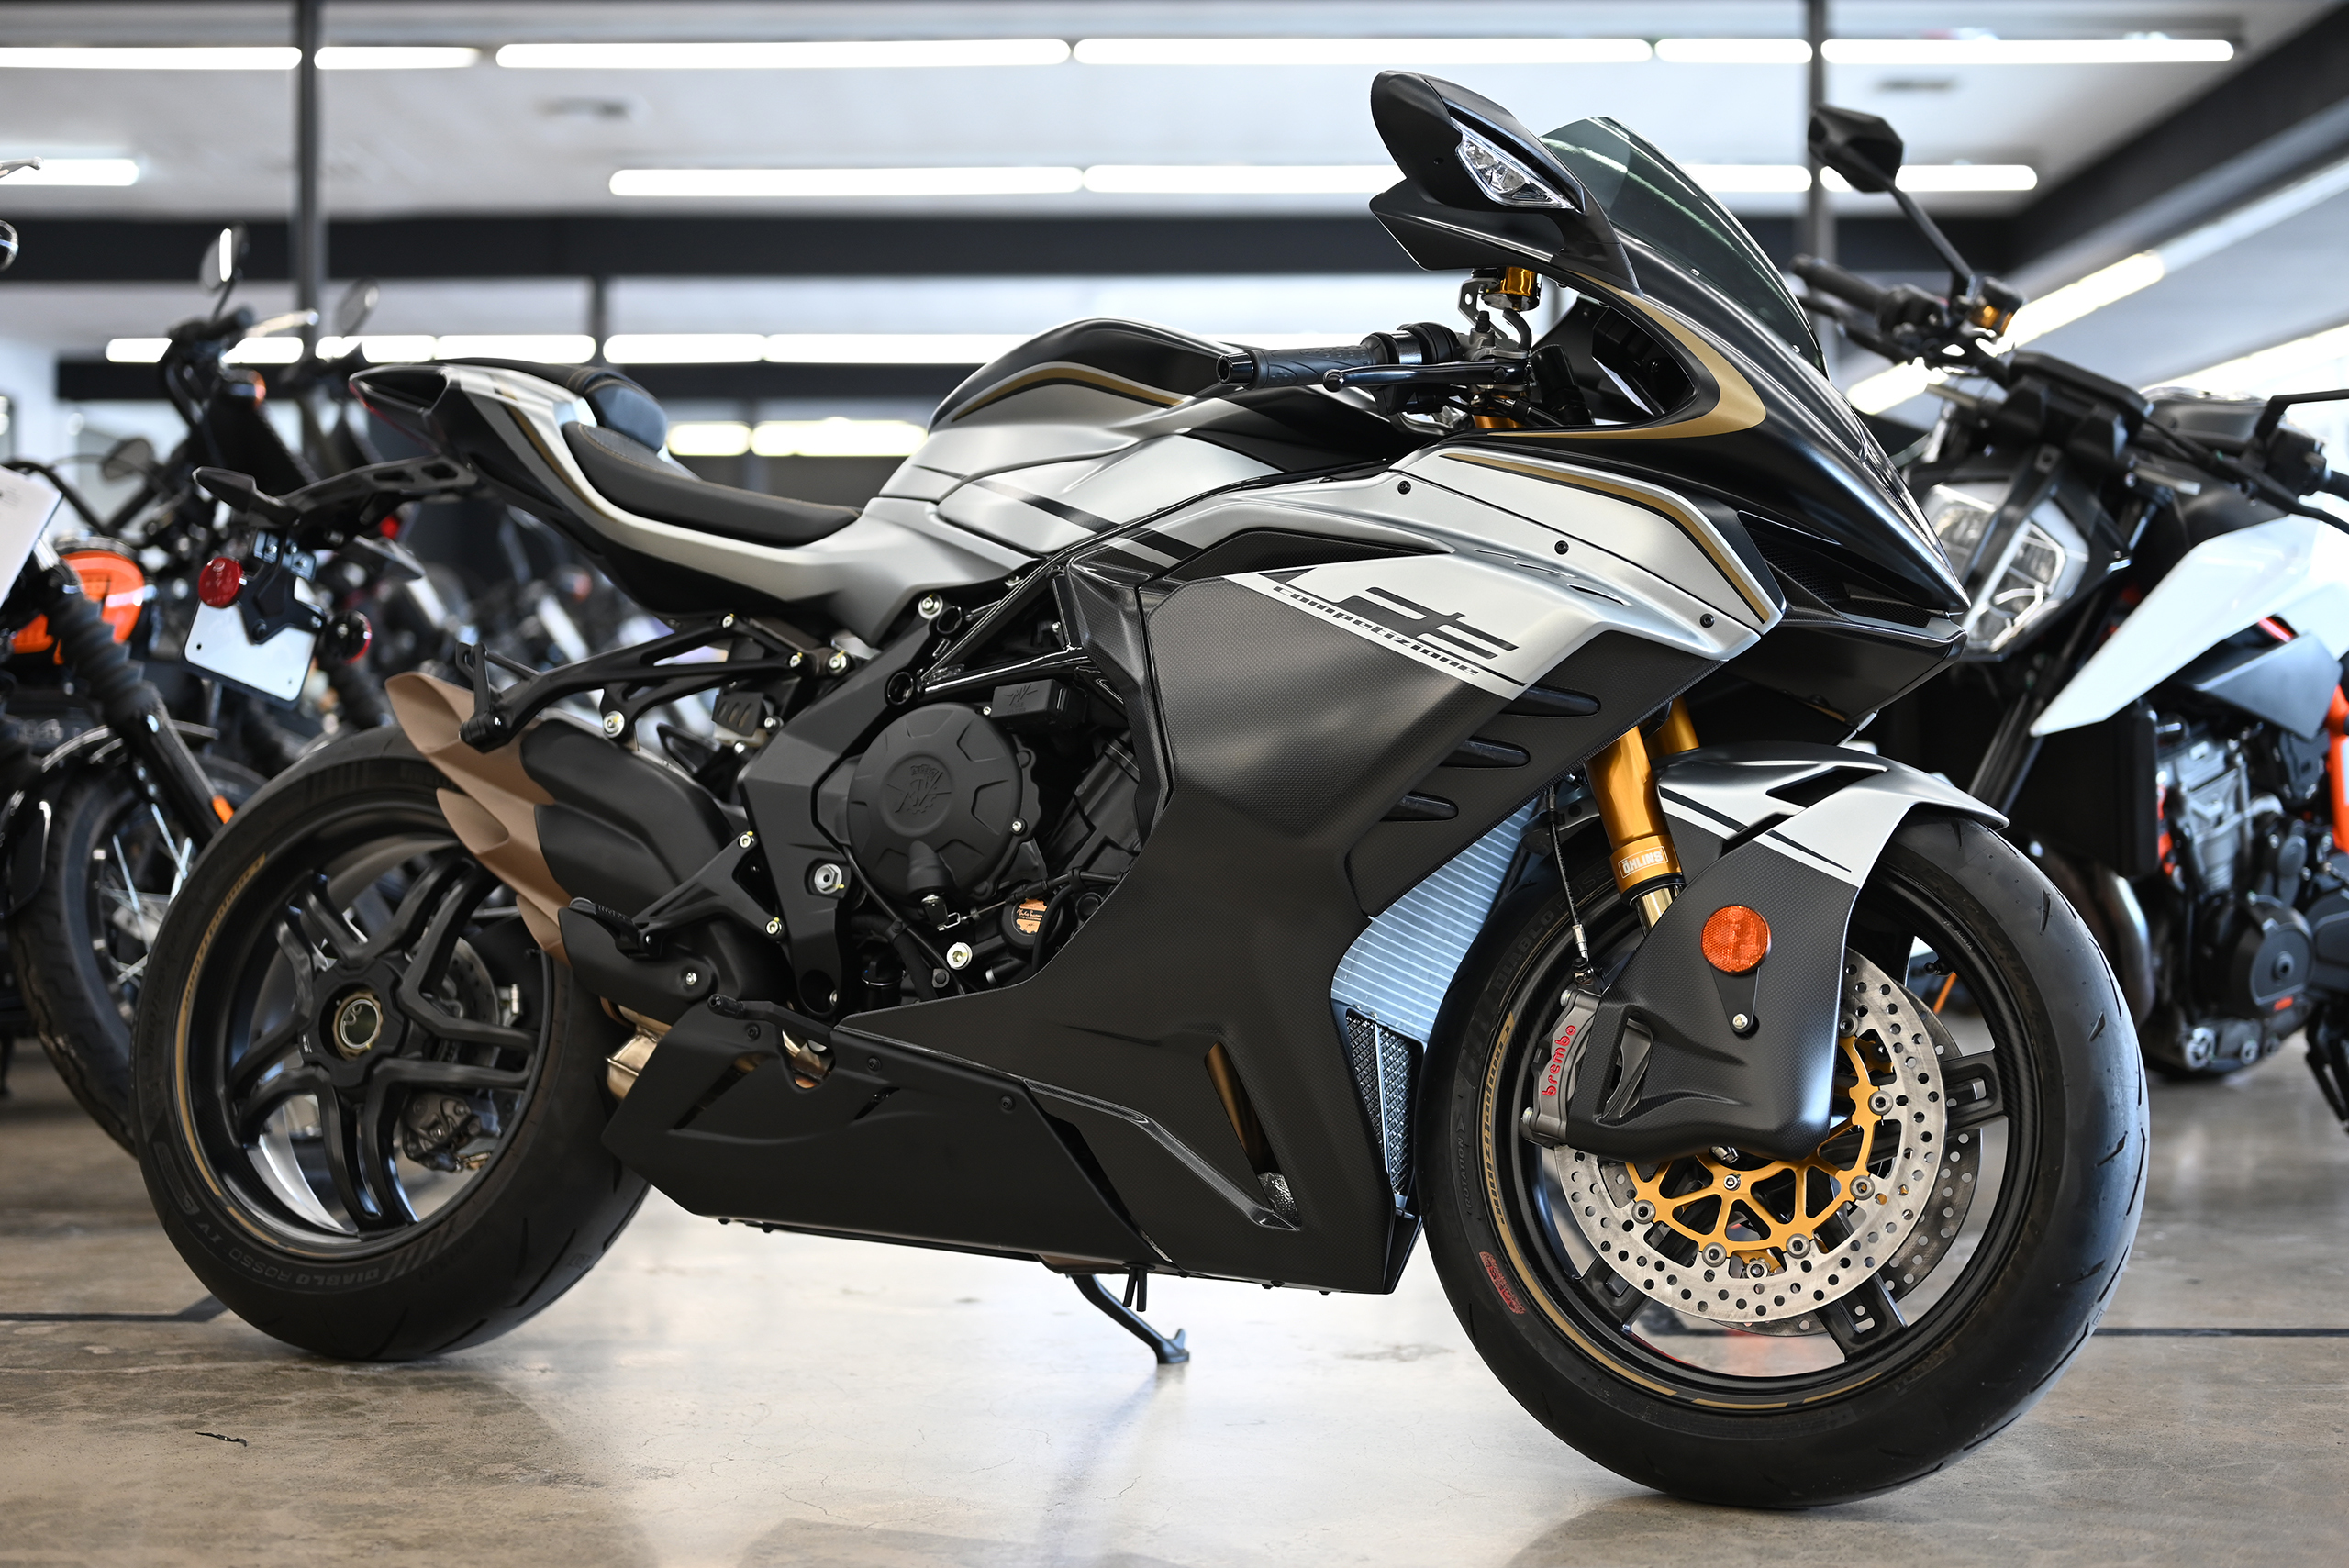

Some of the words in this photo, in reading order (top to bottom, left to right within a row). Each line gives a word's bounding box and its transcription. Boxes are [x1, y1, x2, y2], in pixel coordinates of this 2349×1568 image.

[1621, 851, 1664, 874] ÖHLINS
[1491, 909, 1555, 992] DIABLO
[1542, 1025, 1576, 1097] brembo
[1457, 1137, 1474, 1208] ROTATION
[228, 1246, 293, 1284] ROSSO
[295, 1267, 381, 1286] DIABLO
